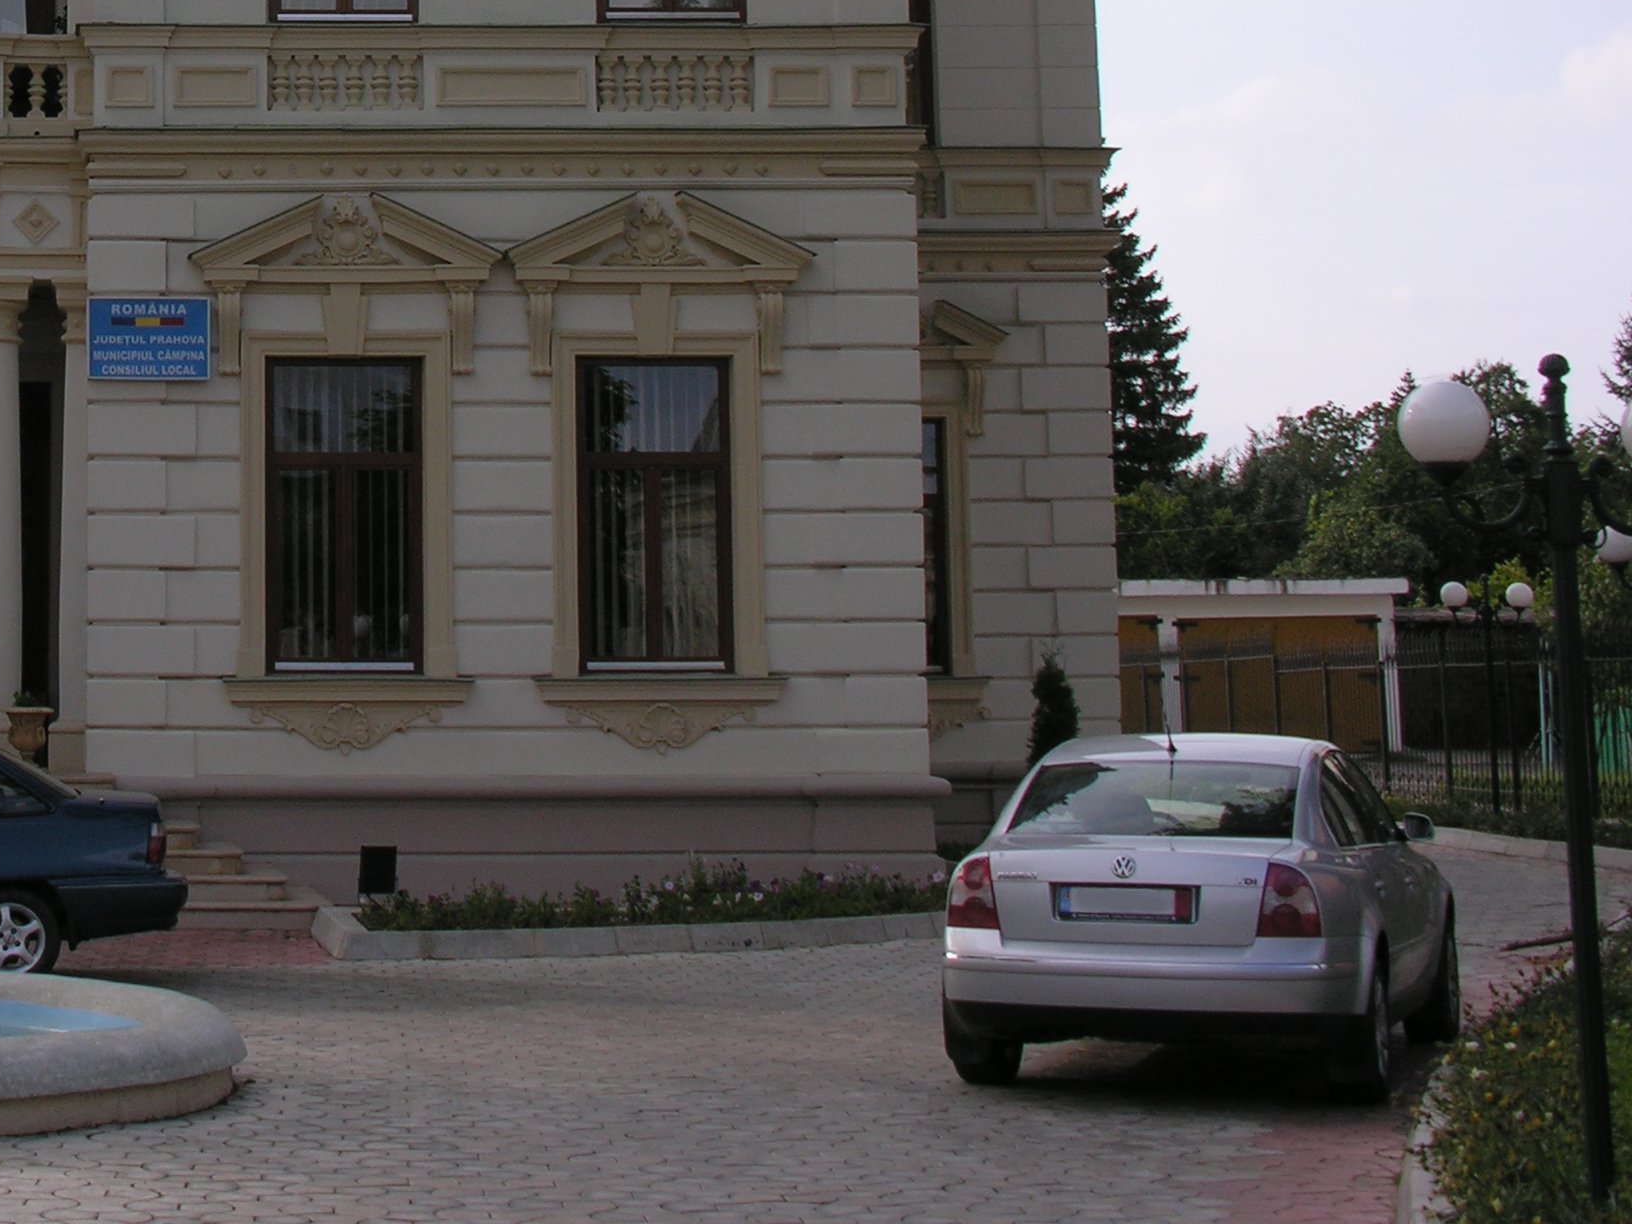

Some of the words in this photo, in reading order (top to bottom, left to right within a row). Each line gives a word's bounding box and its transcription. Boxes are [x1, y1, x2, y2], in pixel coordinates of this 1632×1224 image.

[111, 302, 187, 315] ROMÂNIA
[150, 335, 205, 344] PRAHOVA
[93, 350, 154, 361] MUNICIPIUL
[157, 349, 205, 361] CÂMPINA
[101, 365, 158, 375] CONSILIUL
[162, 365, 196, 375] LOCAL
